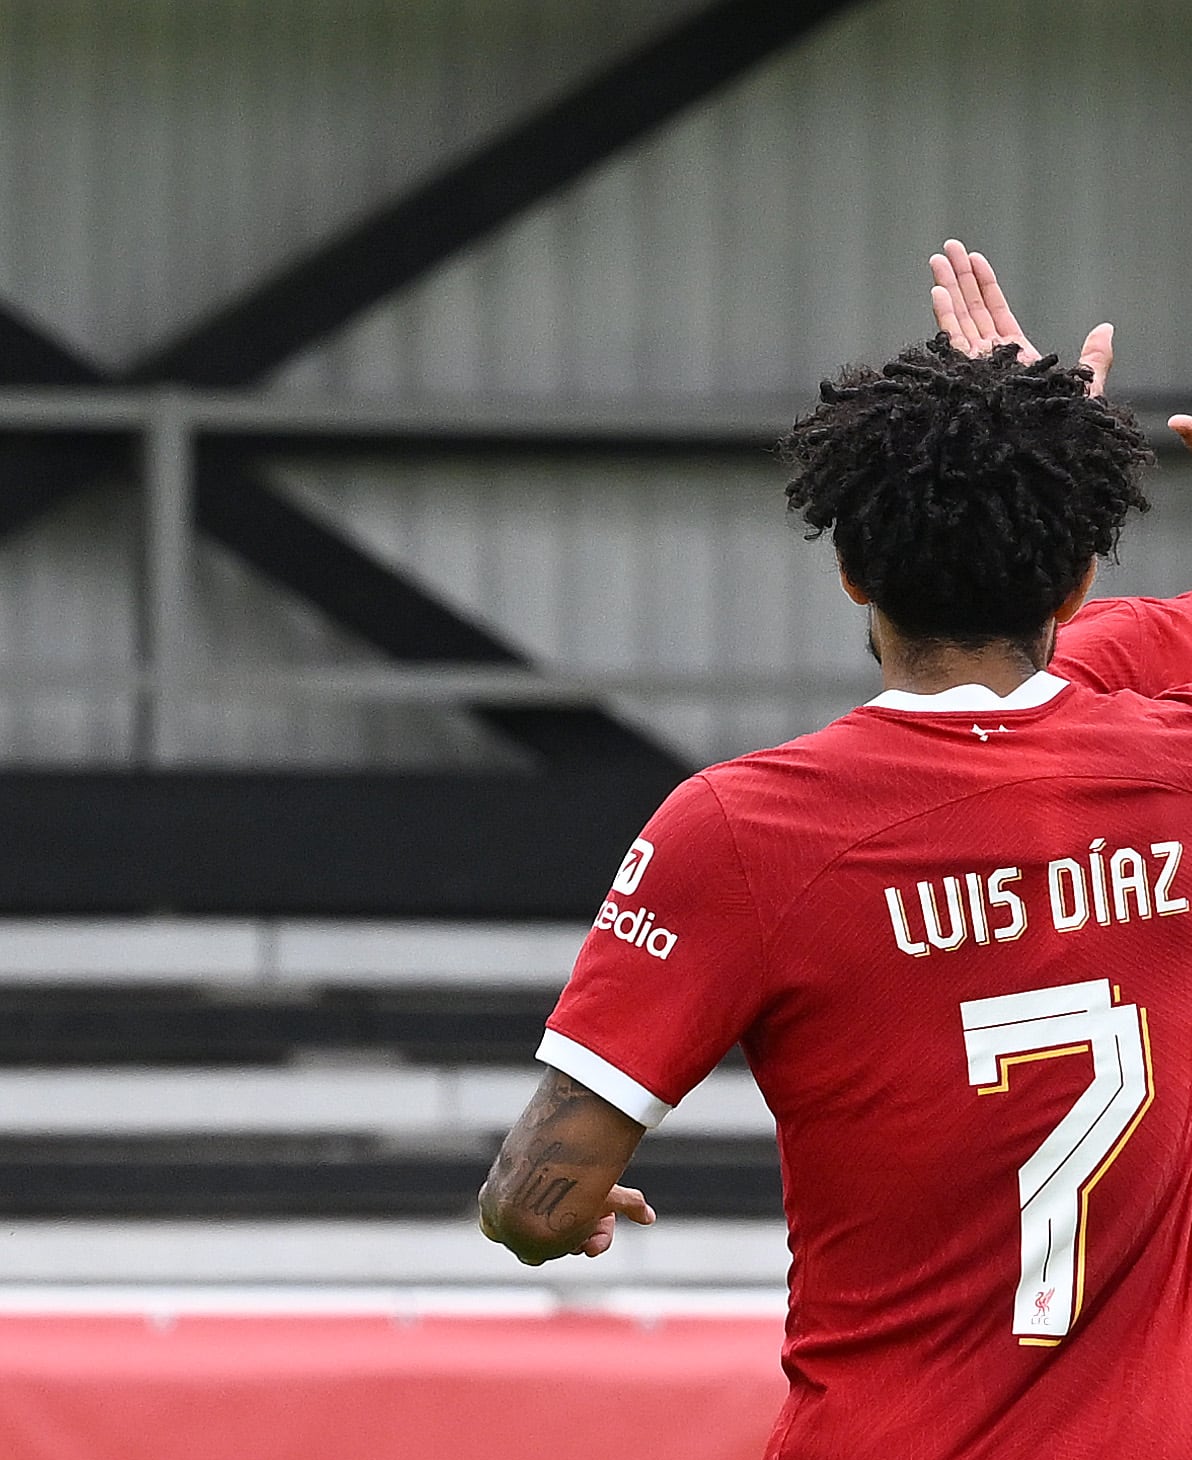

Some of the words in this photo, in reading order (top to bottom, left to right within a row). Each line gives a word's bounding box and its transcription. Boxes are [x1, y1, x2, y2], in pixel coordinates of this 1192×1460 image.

[593, 900, 678, 960] edia
[884, 865, 1027, 957] LUIS
[1047, 837, 1190, 934] DÍAZ
[960, 977, 1155, 1346] 7
